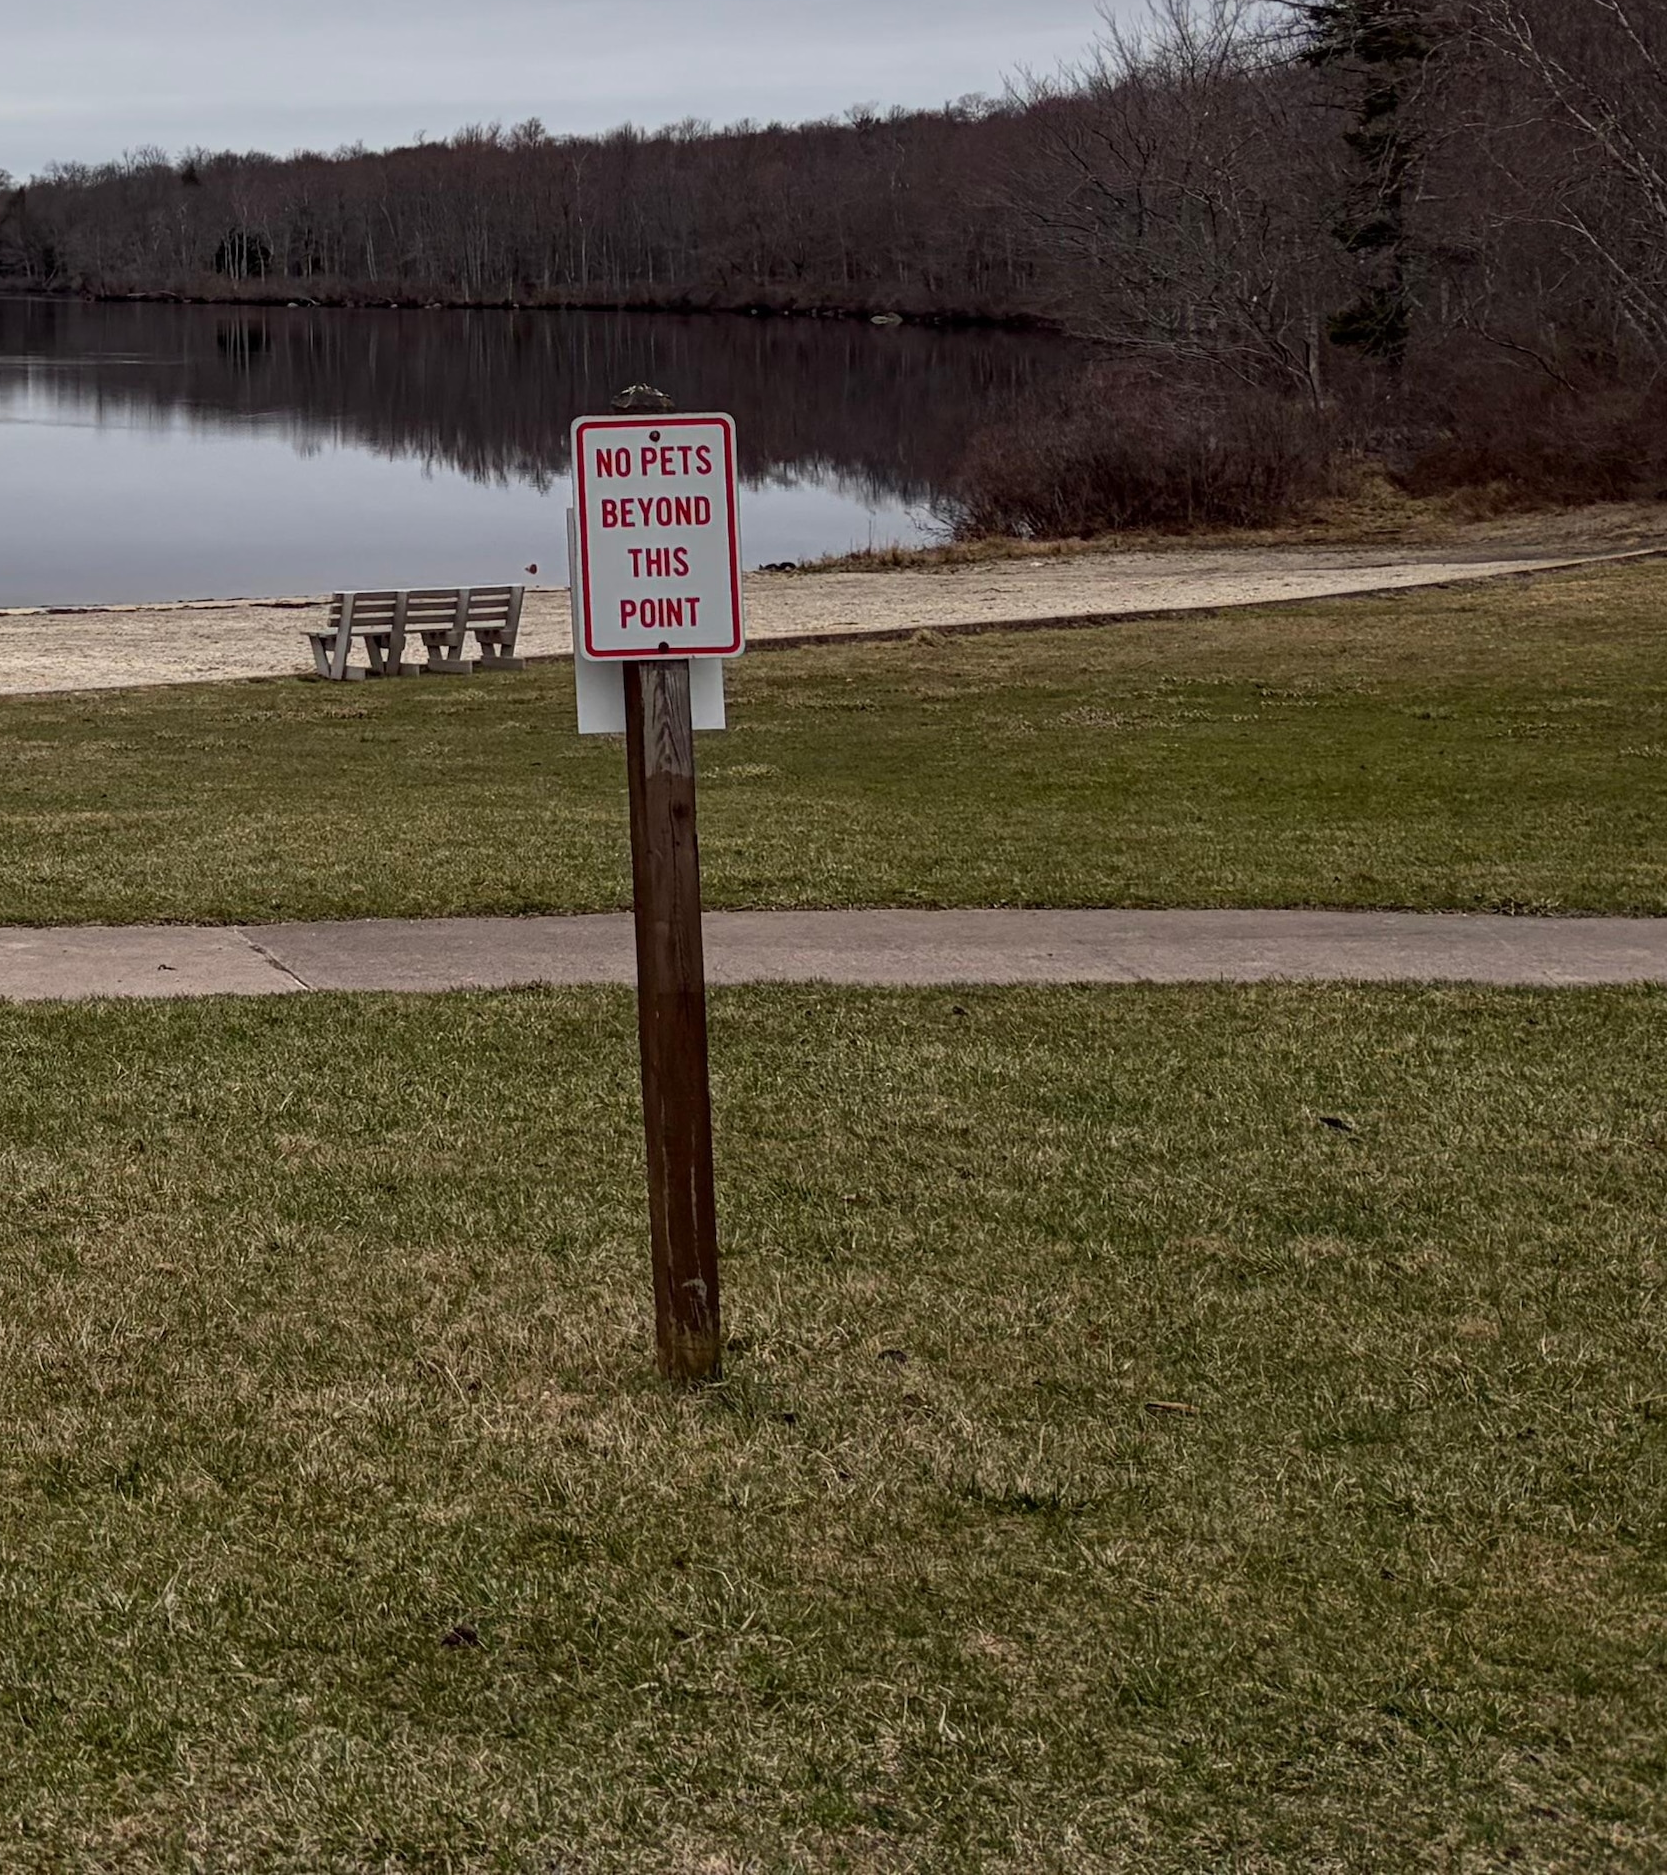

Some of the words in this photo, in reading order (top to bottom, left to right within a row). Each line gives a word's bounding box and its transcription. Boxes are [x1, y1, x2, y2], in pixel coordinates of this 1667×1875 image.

[596, 447, 631, 478] NO
[641, 445, 712, 476] PETS
[601, 496, 711, 528] BEYOND
[628, 547, 689, 578] THIS
[620, 597, 700, 629] POINT
